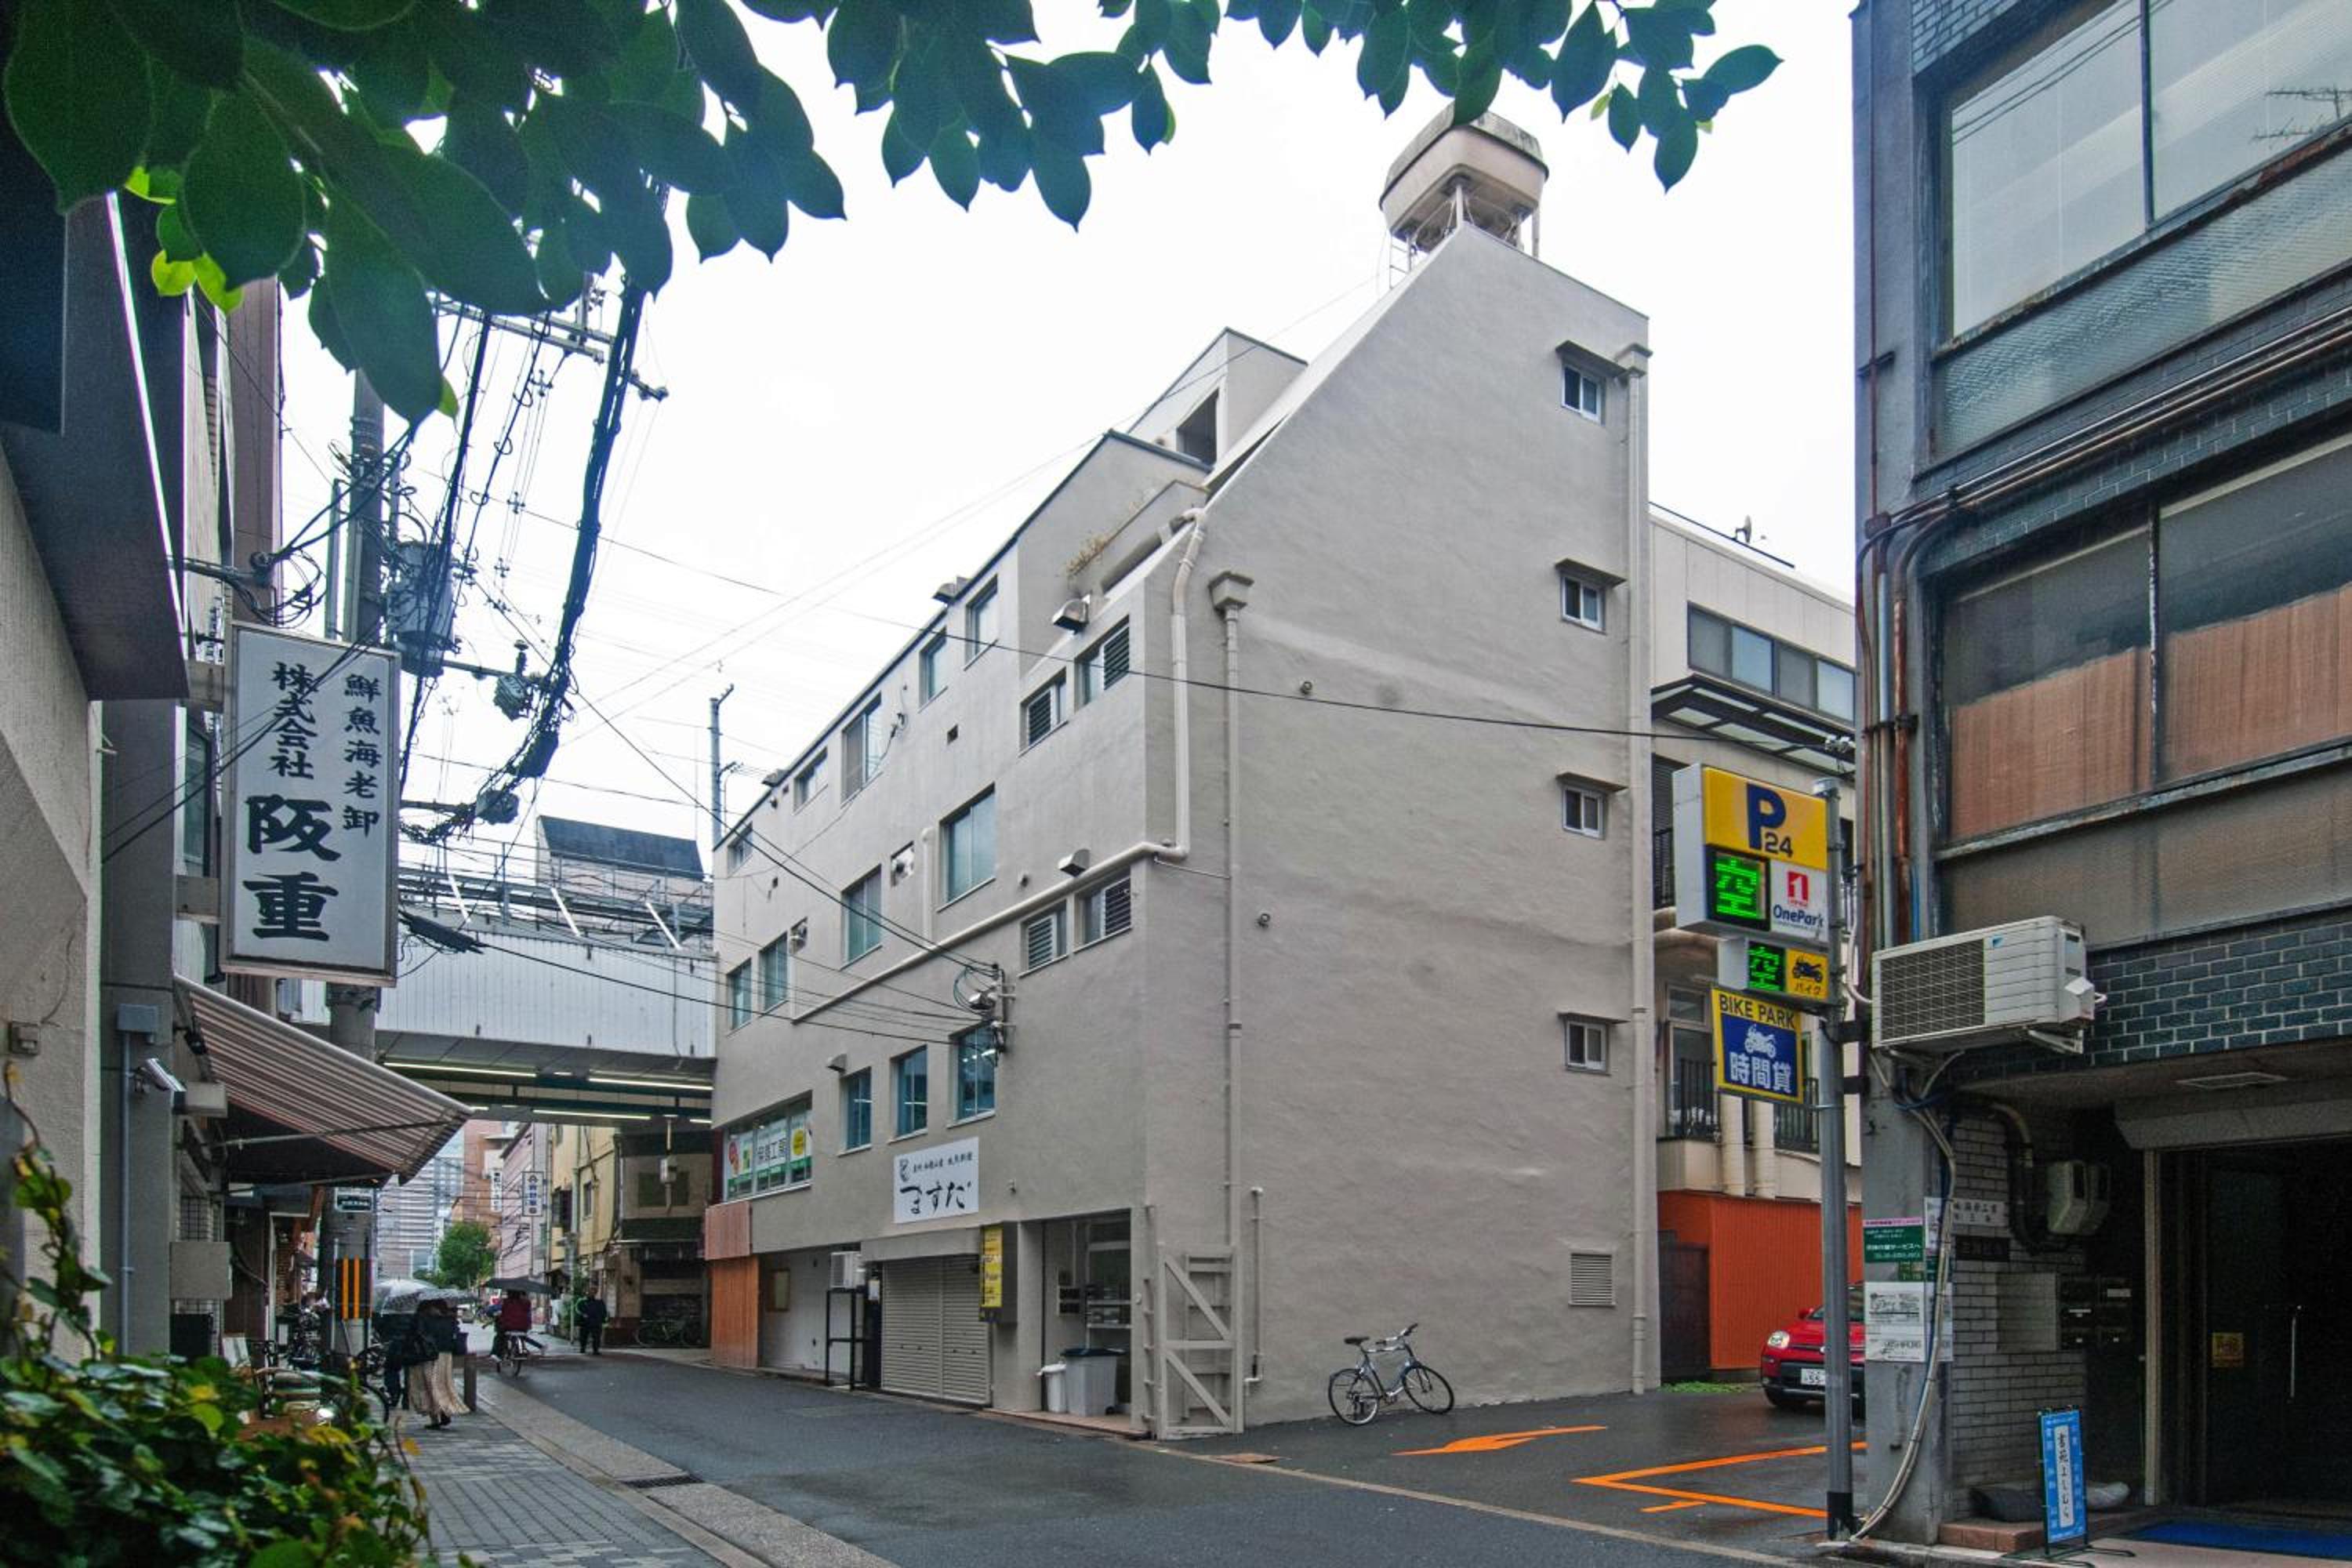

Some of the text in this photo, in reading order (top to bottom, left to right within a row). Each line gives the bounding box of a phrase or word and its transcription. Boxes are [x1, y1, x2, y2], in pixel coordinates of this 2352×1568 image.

[343, 673, 383, 837] 鮮魚海老卸
[242, 661, 342, 942] 株式会社 阪重
[1764, 831, 1794, 858] 24
[1715, 858, 1758, 918] 空
[1773, 904, 1824, 928] OnePark
[1795, 982, 1822, 996] バイク
[1719, 993, 1795, 1029] BIKE PARK
[1730, 1051, 1792, 1094] 時間貸
[899, 1180, 972, 1215] ますだ
